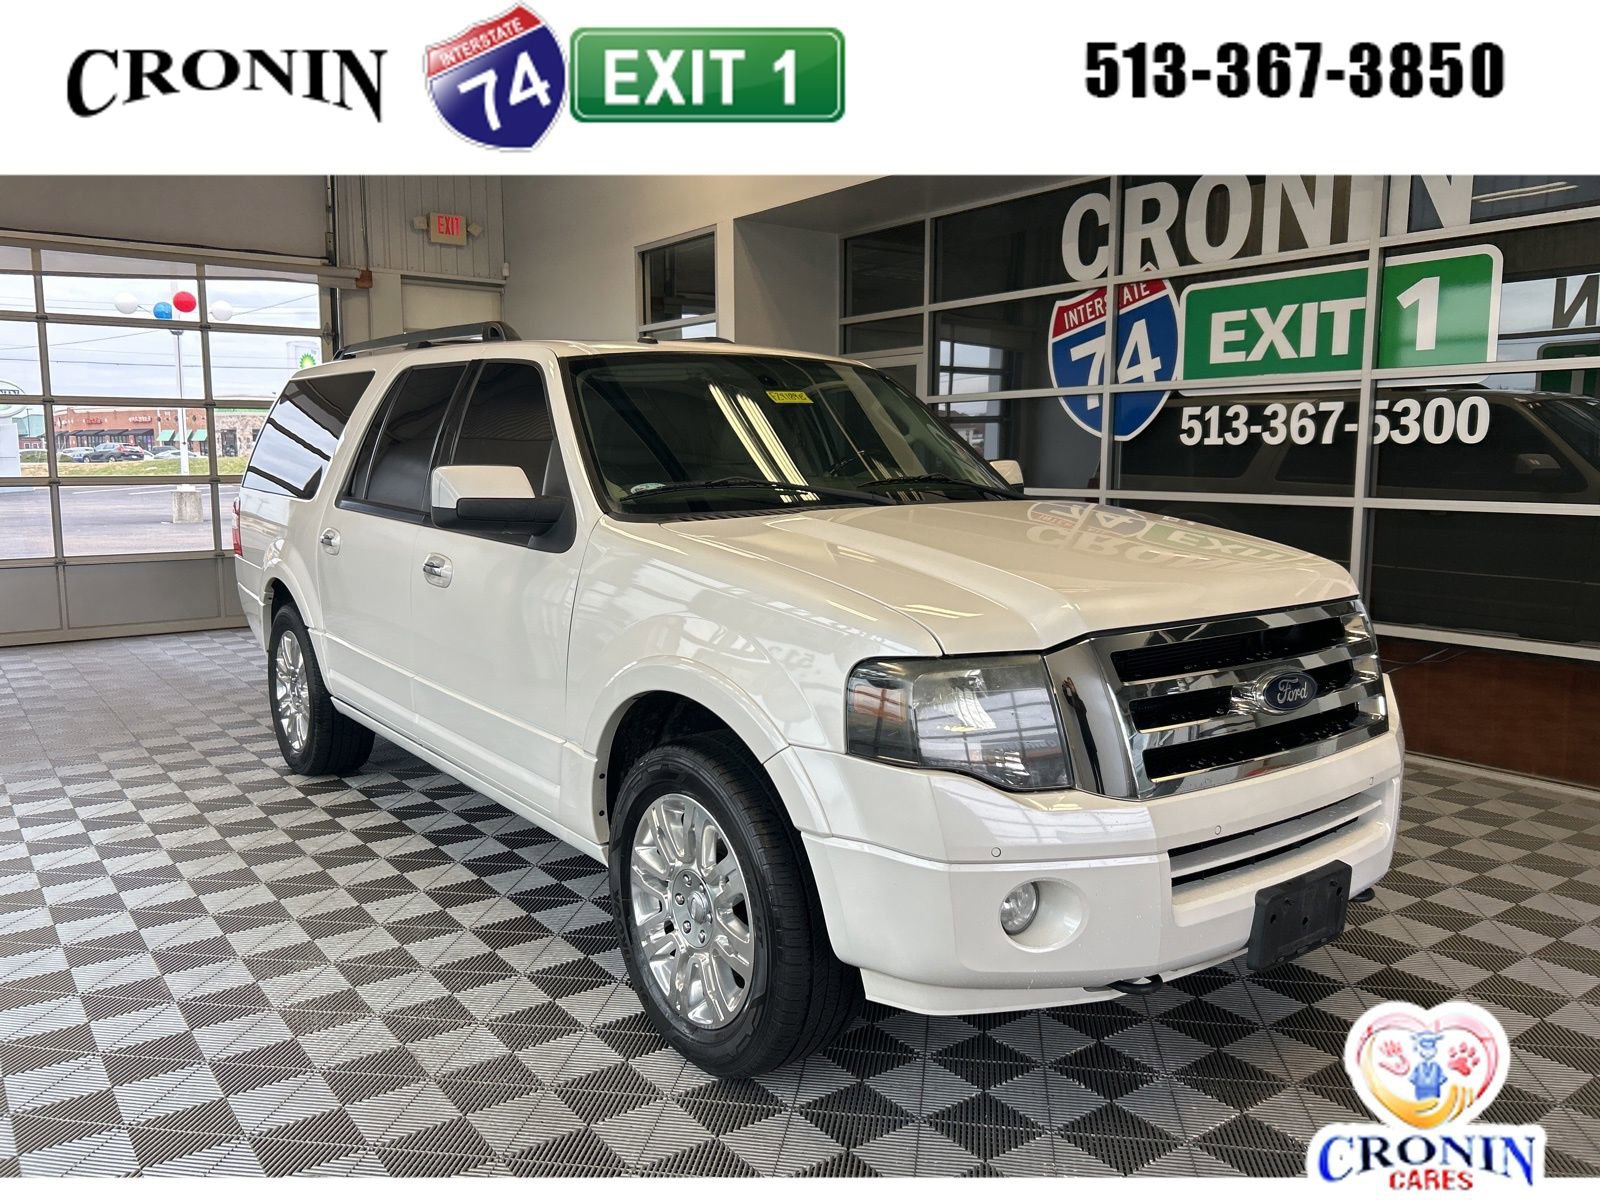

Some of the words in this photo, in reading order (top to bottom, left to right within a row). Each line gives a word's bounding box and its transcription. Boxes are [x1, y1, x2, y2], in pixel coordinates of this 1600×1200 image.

[437, 214, 462, 240] EXIT
[1063, 279, 1150, 330] INTERATE
[1209, 296, 1367, 365] EXIT
[1396, 276, 1442, 351] 1
[1070, 318, 1162, 411] 74
[1179, 396, 1490, 446] 513-367-5300
[1277, 677, 1308, 704] Ford
